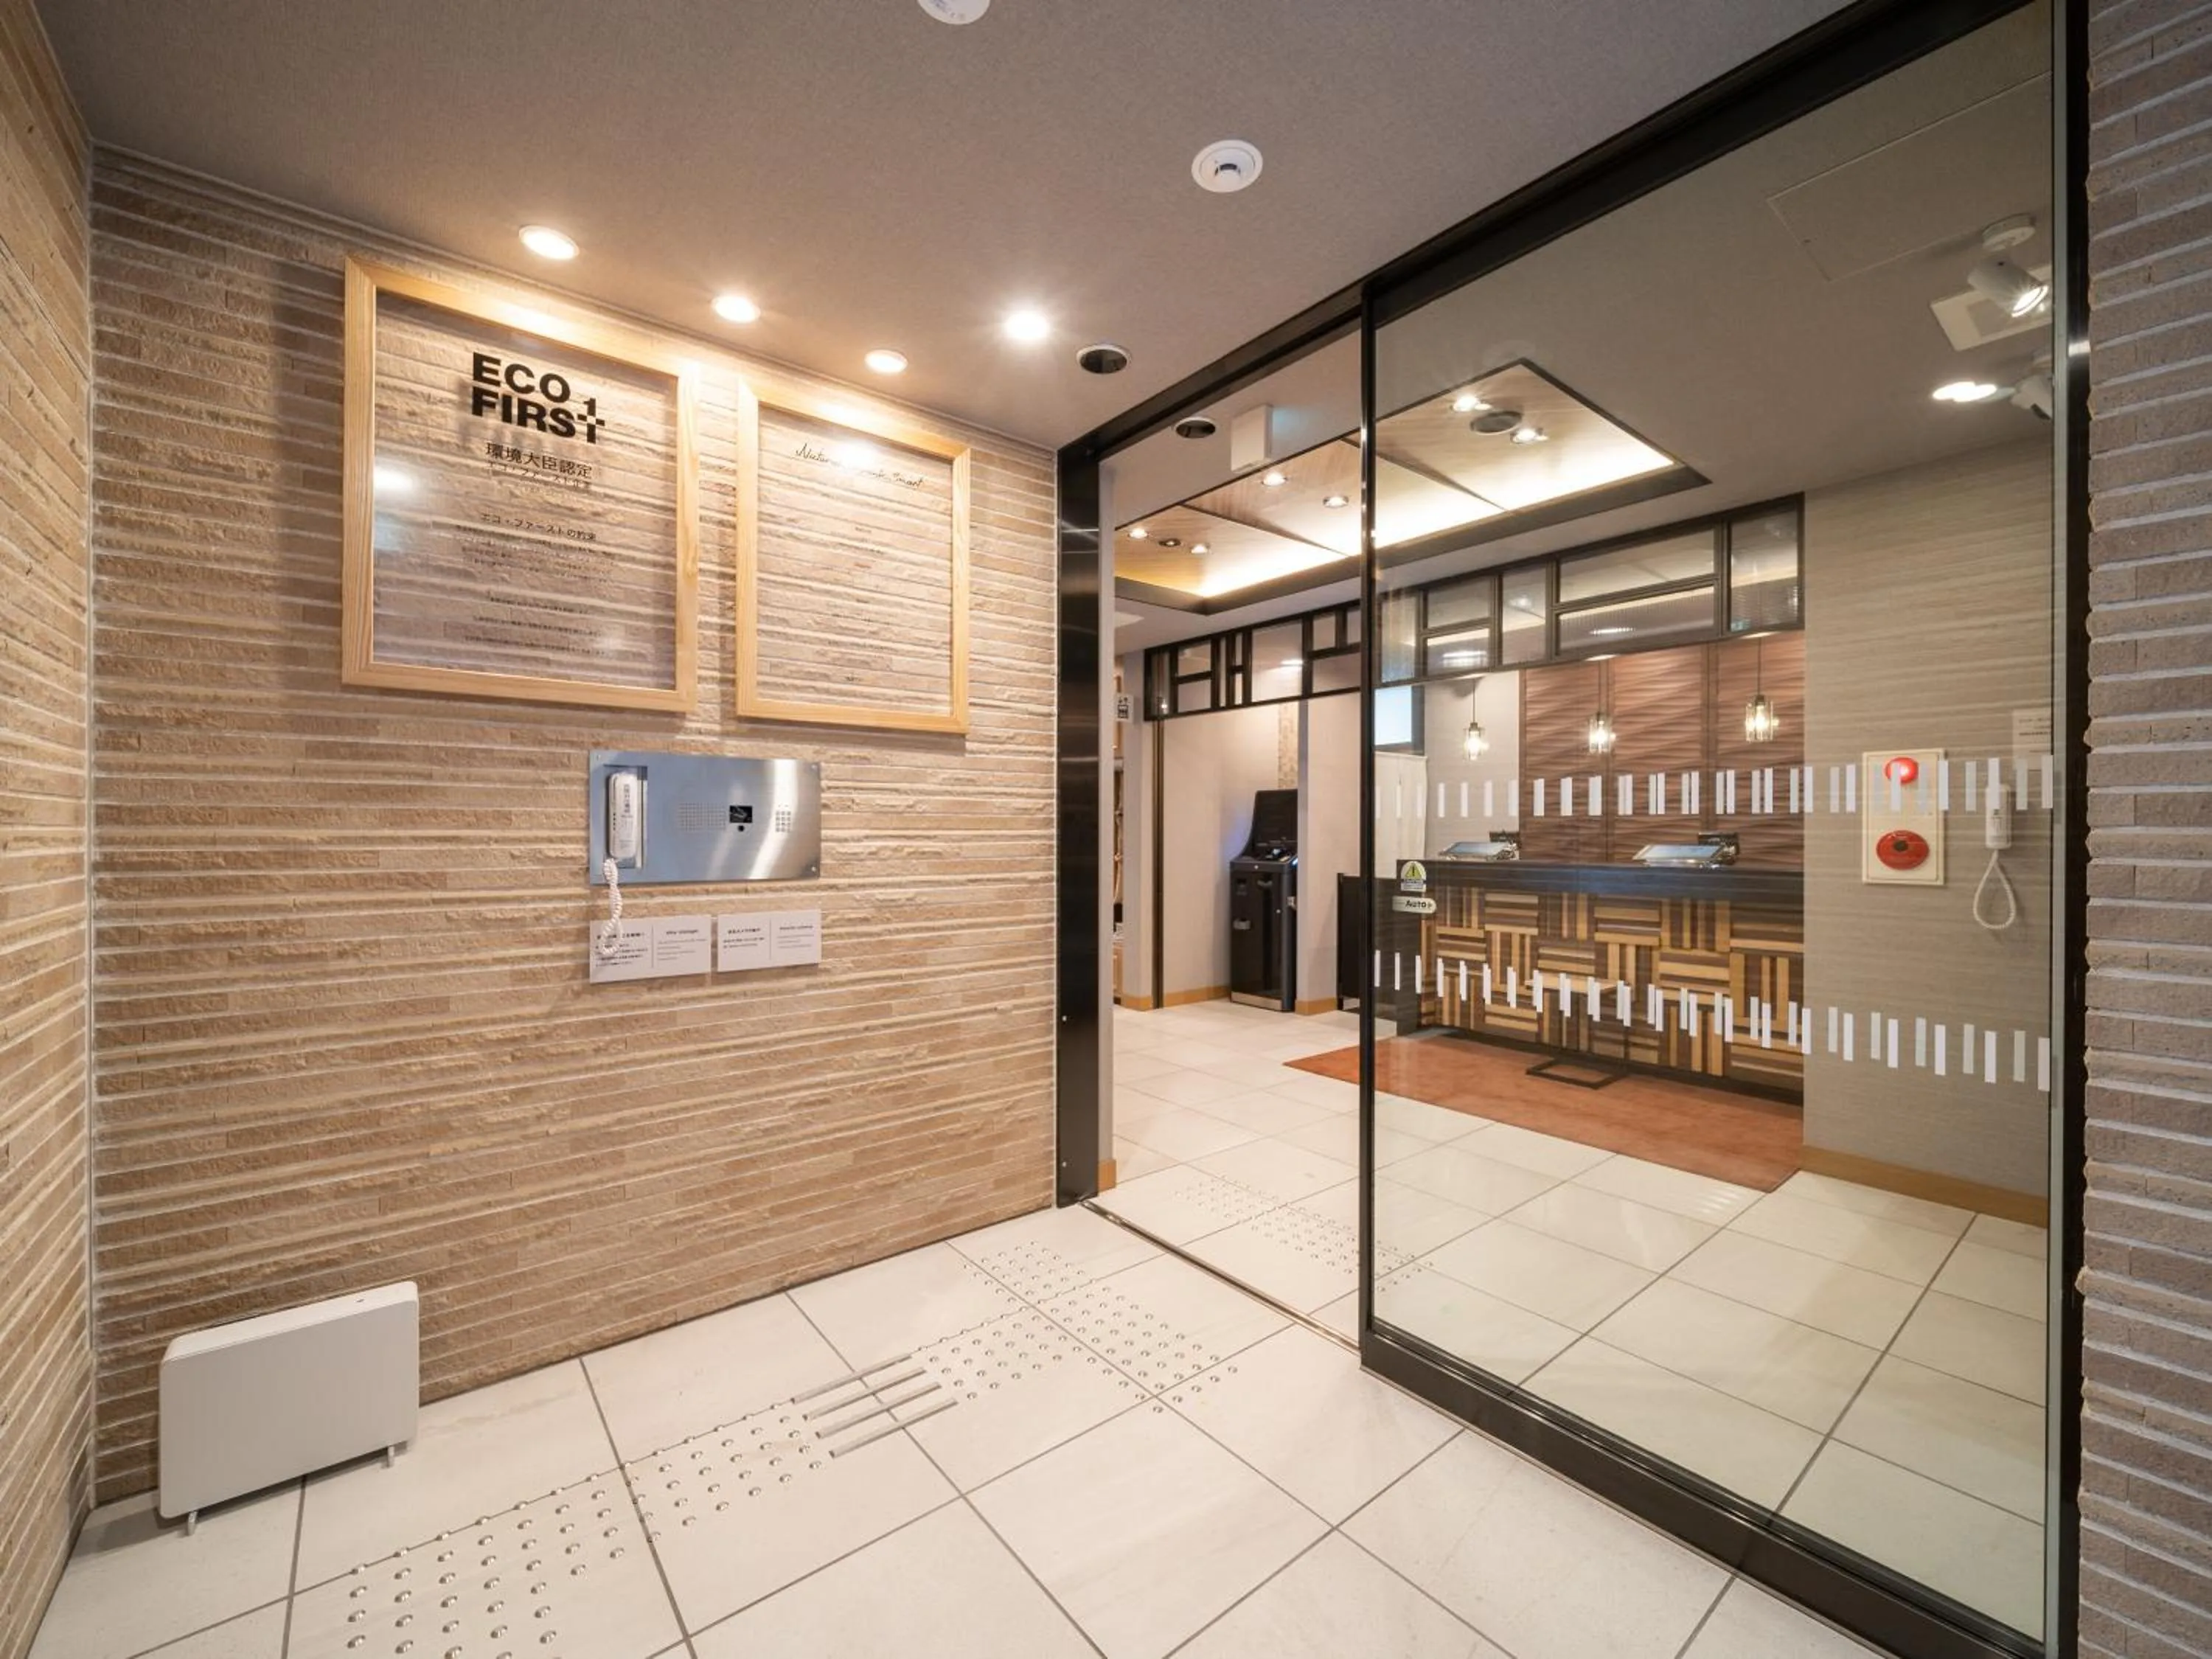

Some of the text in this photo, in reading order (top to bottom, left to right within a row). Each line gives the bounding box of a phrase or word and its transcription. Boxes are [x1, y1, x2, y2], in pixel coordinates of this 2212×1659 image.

[473, 352, 571, 403] ECO
[471, 386, 605, 444] FIRST
[486, 442, 592, 479] 環境大臣認定
